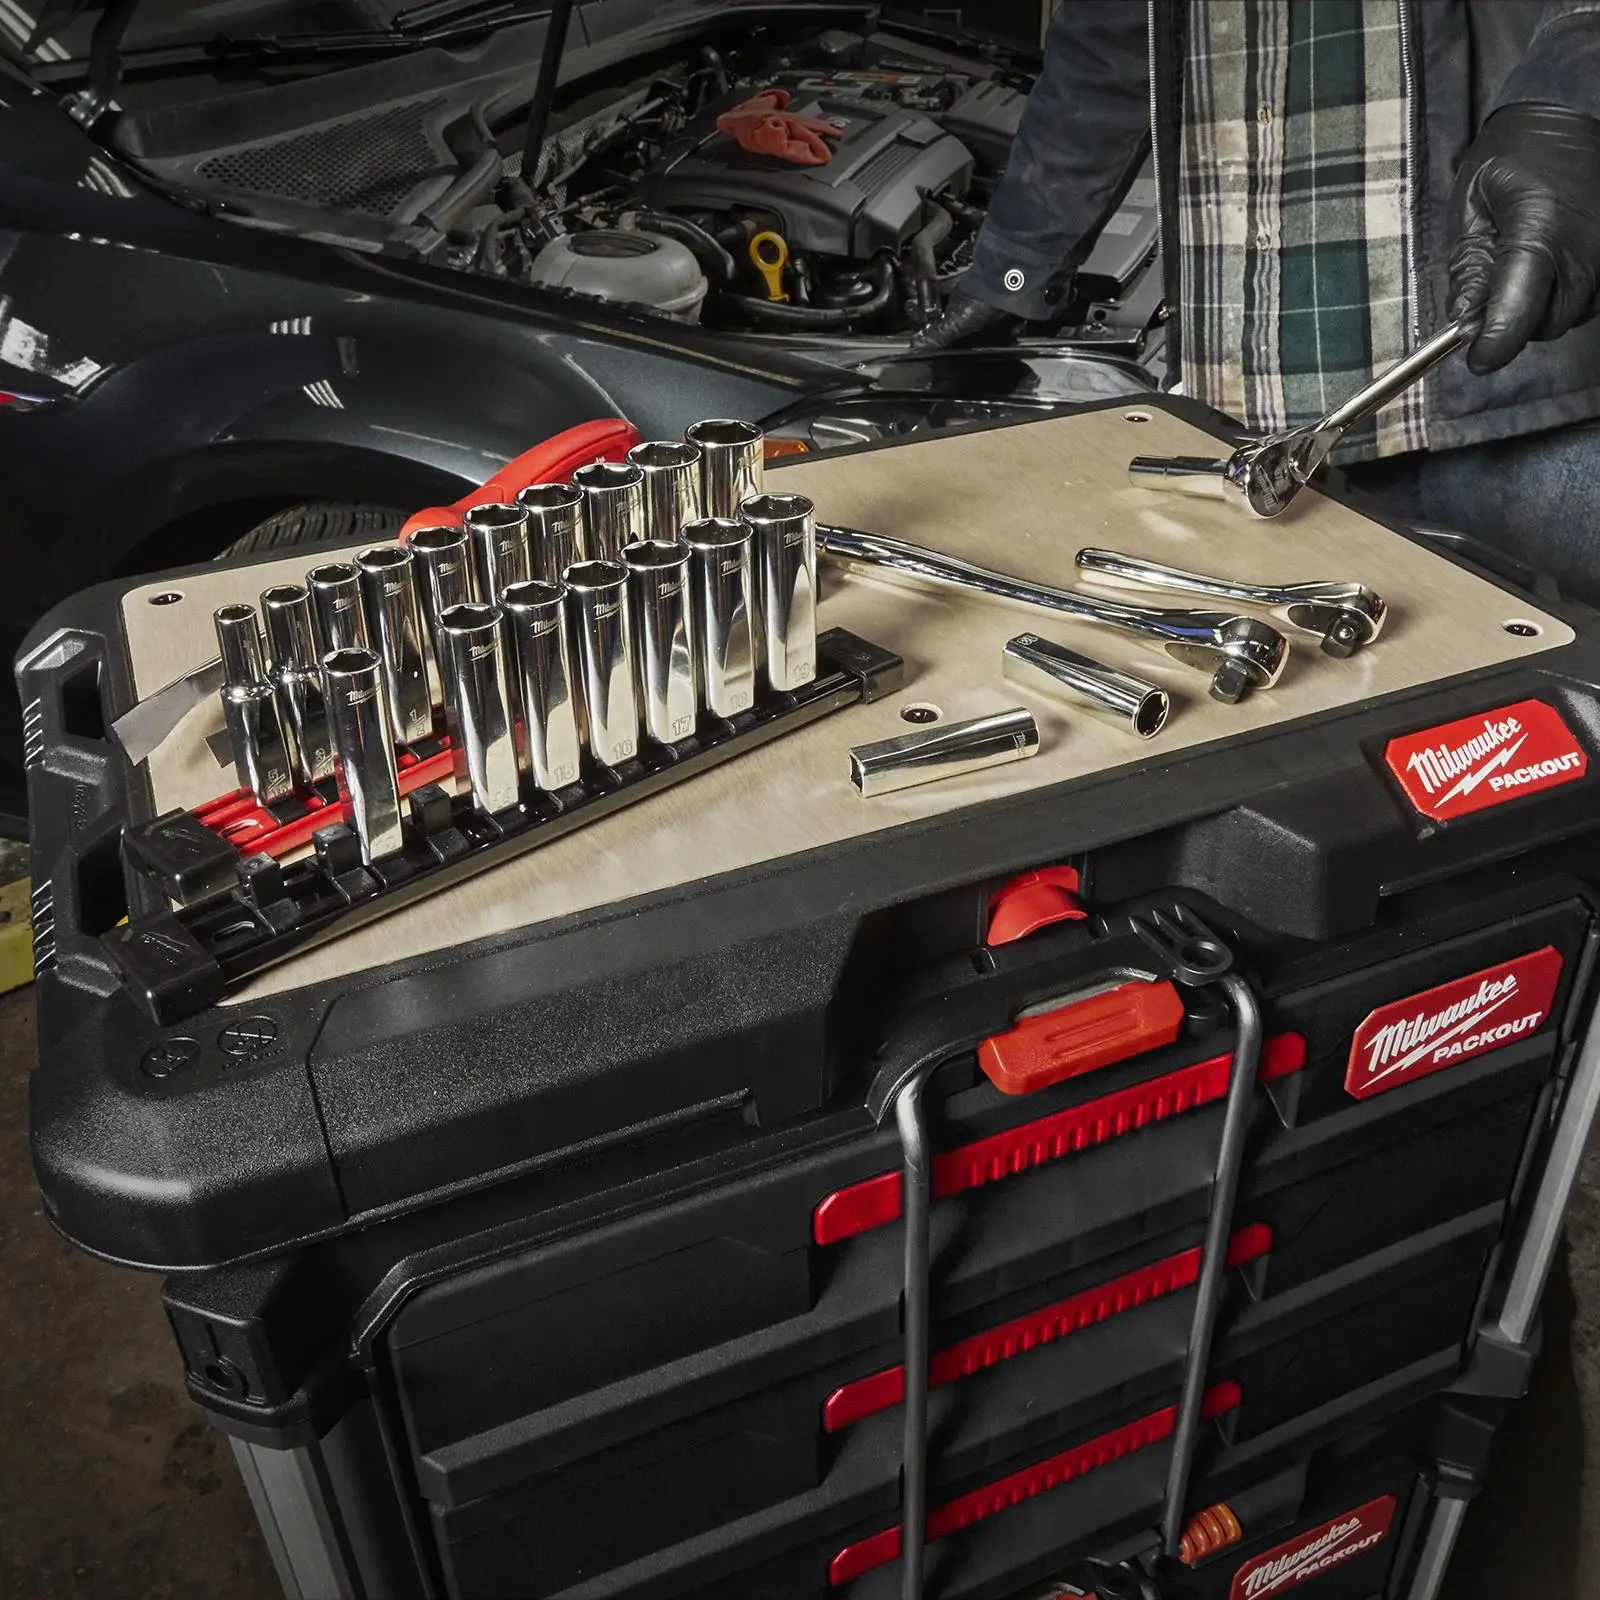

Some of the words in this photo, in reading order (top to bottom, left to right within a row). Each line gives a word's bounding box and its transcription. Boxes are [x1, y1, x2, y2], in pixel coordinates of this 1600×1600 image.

[672, 714, 691, 737] 17
[1406, 716, 1522, 794] Milwaukee
[1488, 751, 1582, 792] PACKOUT
[1363, 973, 1518, 1073] Milwaukee
[1432, 1011, 1543, 1064] PACKOUT
[1241, 1516, 1361, 1596] Milwaukee
[1295, 1531, 1383, 1580] PACKOUT
